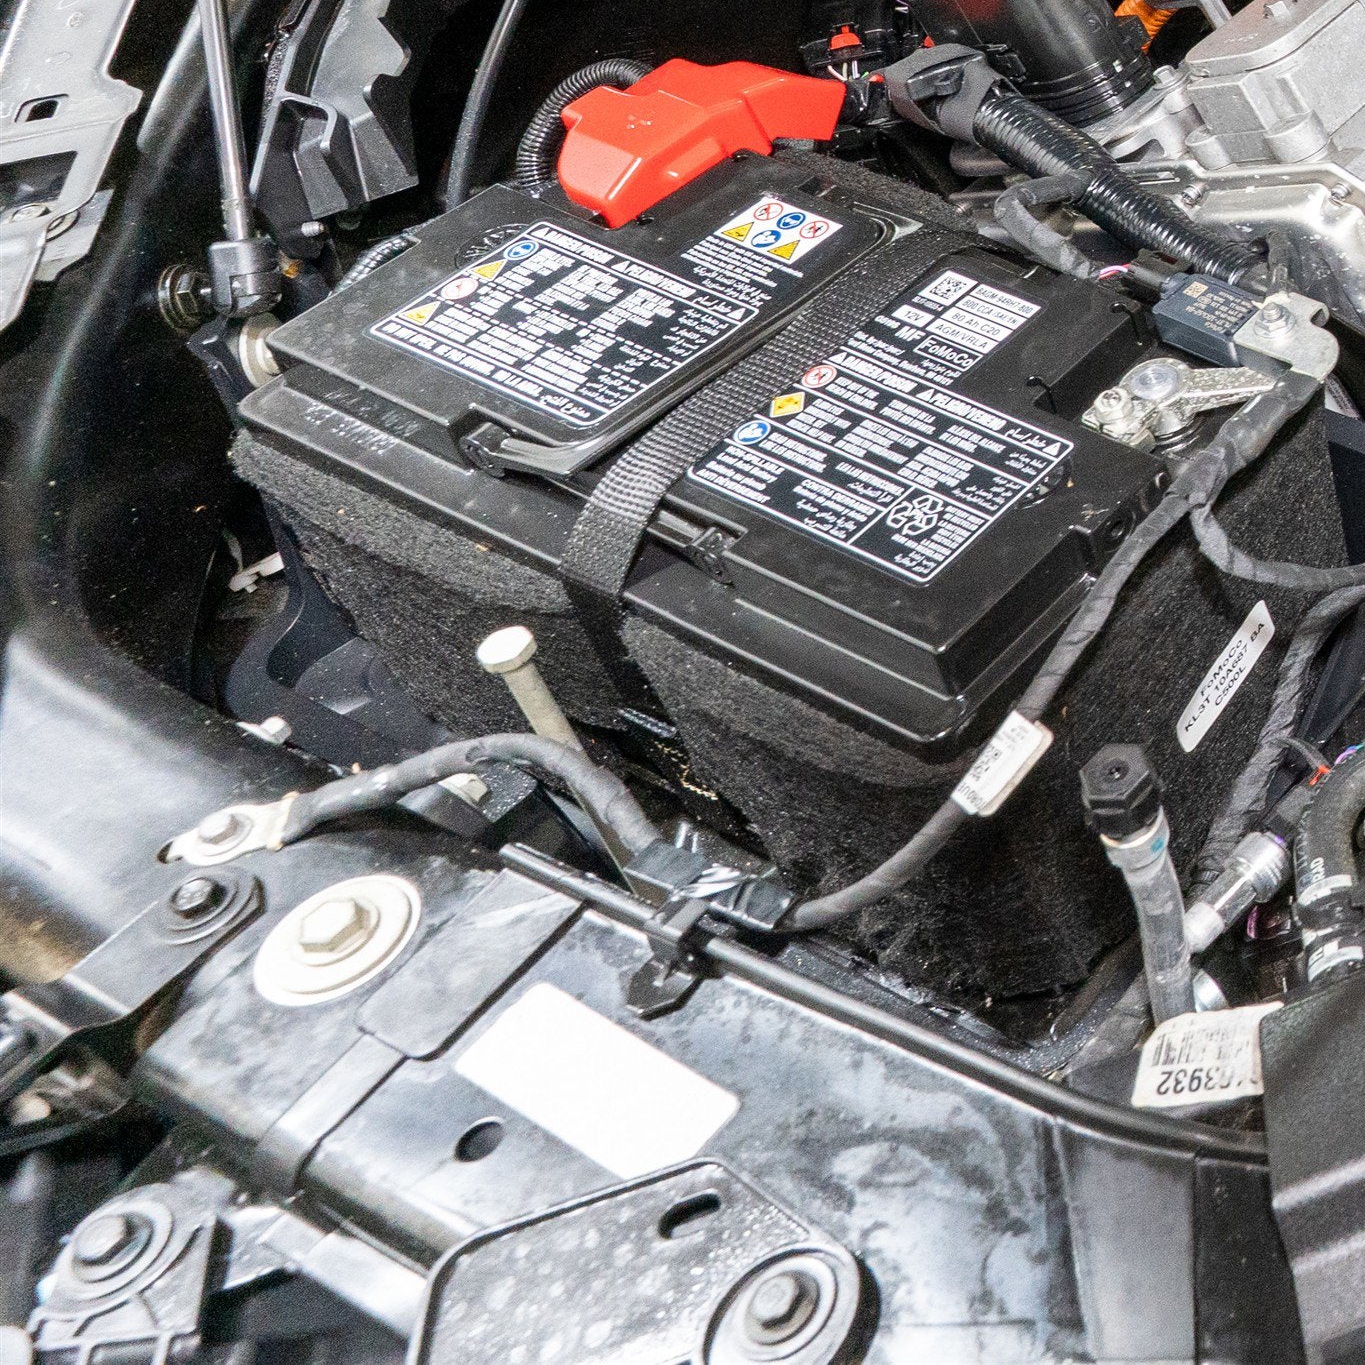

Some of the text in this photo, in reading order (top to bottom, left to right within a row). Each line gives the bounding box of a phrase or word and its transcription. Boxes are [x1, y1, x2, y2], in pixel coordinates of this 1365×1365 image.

[903, 310, 924, 322] 12V
[961, 299, 979, 309] 800
[975, 304, 993, 315] CCA
[893, 324, 926, 344] MF
[934, 322, 989, 349] AGM/VRLA
[951, 312, 1001, 336] 80 Ah C20
[919, 337, 976, 367] FoMoCo
[1250, 622, 1265, 642] BA
[1200, 639, 1243, 697] FoMoCo
[1214, 666, 1247, 707] C500L
